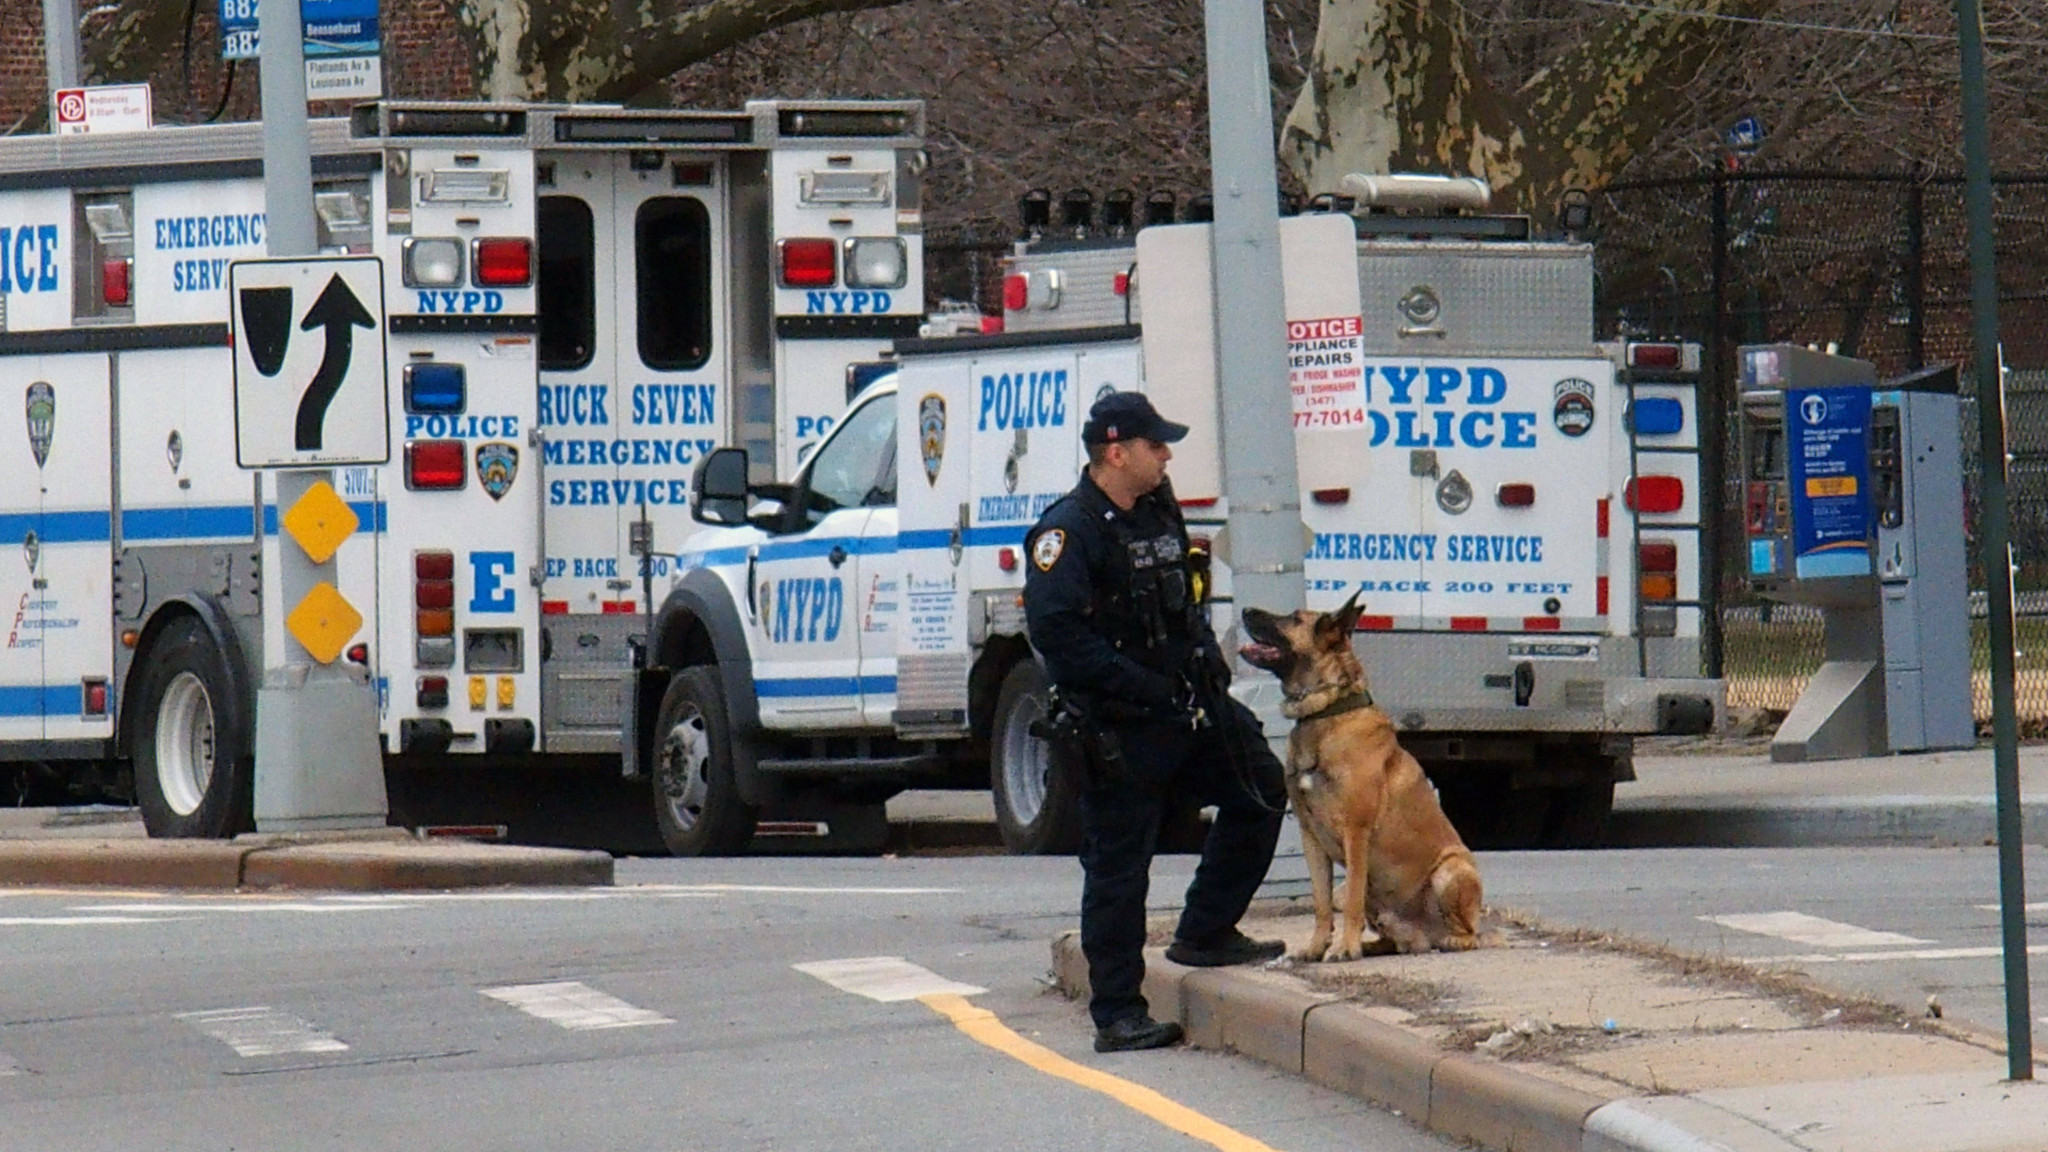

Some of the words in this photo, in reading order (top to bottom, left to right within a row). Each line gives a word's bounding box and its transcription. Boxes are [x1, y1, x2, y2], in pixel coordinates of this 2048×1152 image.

[306, 22, 362, 35] Bensonhurst
[310, 60, 348, 74] Flatlands
[351, 59, 361, 72] Av
[311, 76, 350, 89] Louisiana
[354, 75, 365, 87] Av
[417, 291, 504, 314] NYPD
[806, 291, 892, 314] NYPD
[1290, 319, 1358, 340] OTICE
[1304, 369, 1328, 381] FRIDGE
[1332, 367, 1361, 379] WASHER
[1311, 381, 1356, 394] DISHWASHER
[632, 383, 716, 425] SEVEN
[977, 369, 1068, 432] POLICE
[405, 416, 519, 438] POLICE
[550, 480, 686, 506] SERVICE
[1304, 533, 1437, 561] MERGENCY
[1447, 535, 1543, 563] SERVICE
[573, 558, 618, 578] BACK
[469, 551, 515, 613] E
[1360, 581, 1432, 593] BACK
[1444, 581, 1494, 594] 200
[1507, 583, 1574, 595] FEET
[773, 576, 843, 643] NYPD
